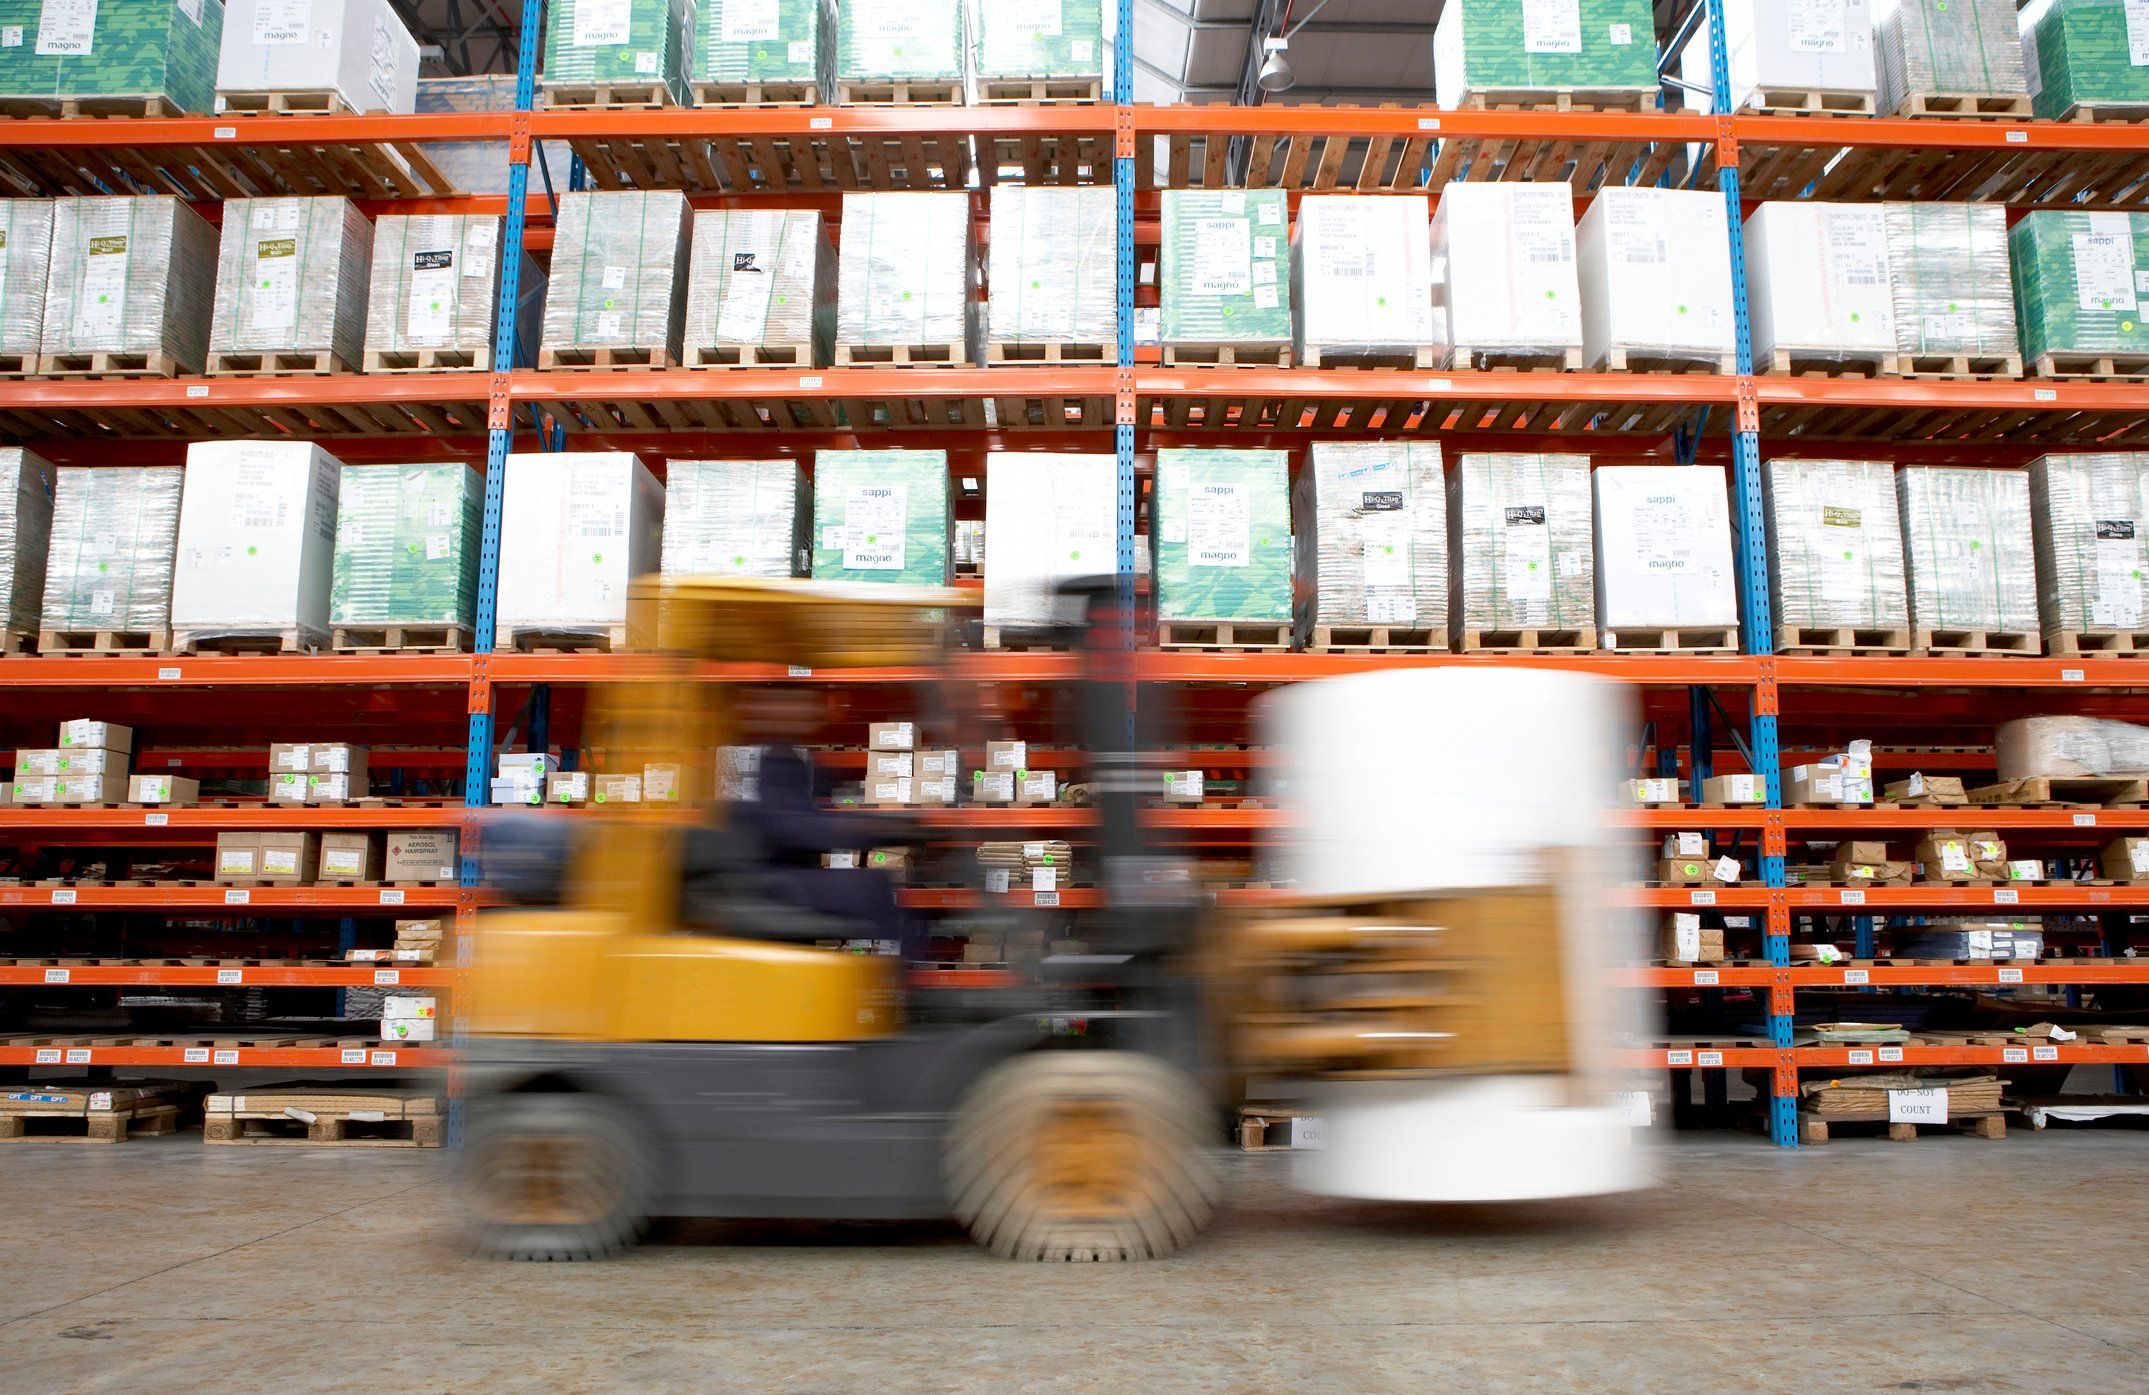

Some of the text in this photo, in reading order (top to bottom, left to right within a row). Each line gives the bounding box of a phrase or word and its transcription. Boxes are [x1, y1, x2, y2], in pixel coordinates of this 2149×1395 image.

[264, 30, 298, 41] magno
[584, 31, 618, 40] magno
[48, 40, 81, 51] magno
[1536, 40, 1570, 48] magno
[1801, 38, 1834, 48] magno
[1206, 220, 1236, 230] sappi
[2087, 236, 2114, 246] sappi
[1203, 281, 1239, 290] magno
[862, 488, 892, 498] sappi
[1204, 485, 1234, 496] sappi
[1364, 494, 1401, 504] Hi-Q Titan
[1646, 494, 1676, 504] sappi
[856, 554, 892, 564] magno
[1200, 552, 1237, 561] magno
[1648, 560, 1684, 570] magno
[1900, 1106, 1932, 1114] COUNT
